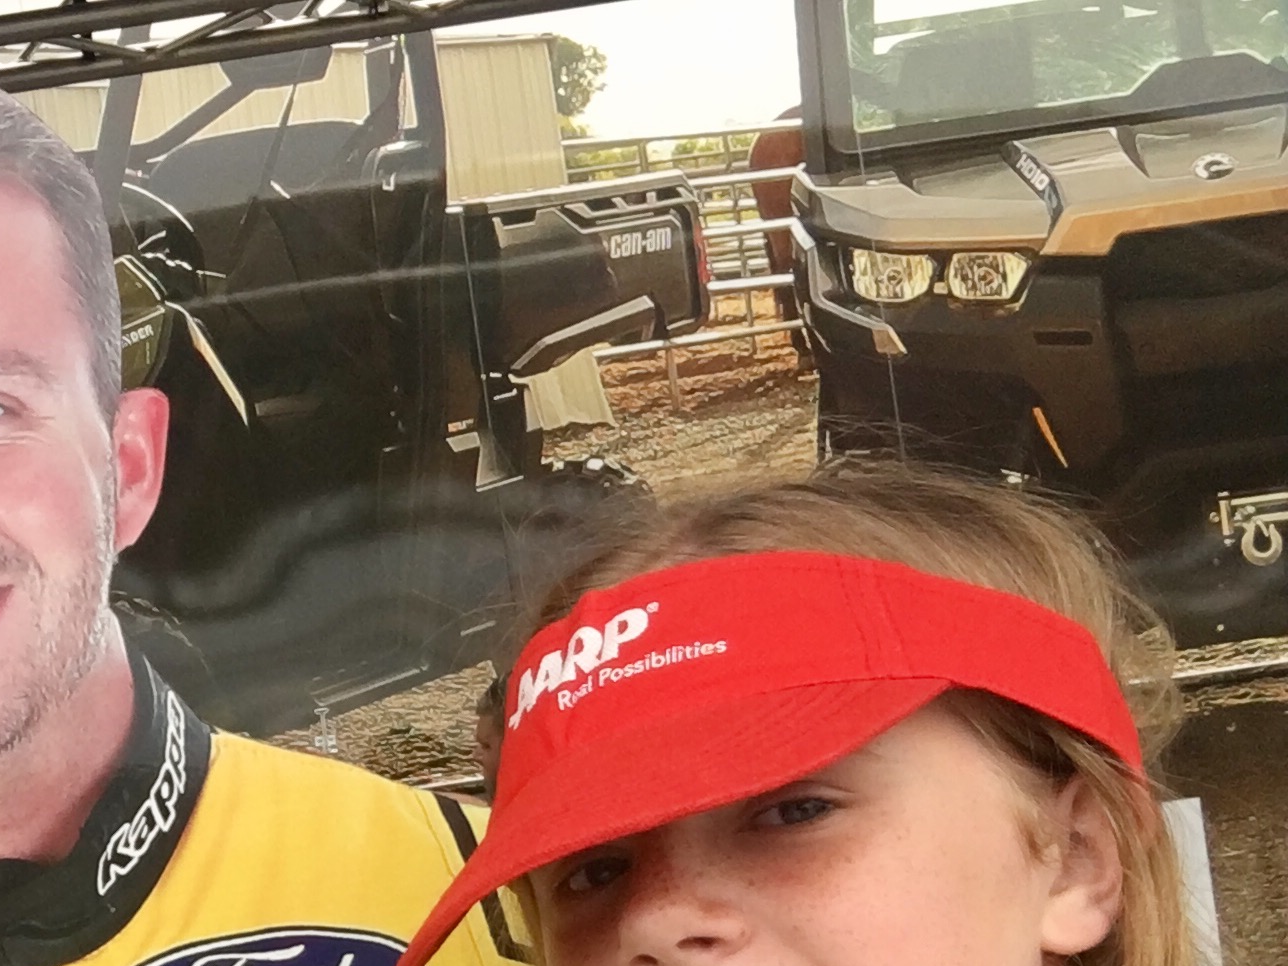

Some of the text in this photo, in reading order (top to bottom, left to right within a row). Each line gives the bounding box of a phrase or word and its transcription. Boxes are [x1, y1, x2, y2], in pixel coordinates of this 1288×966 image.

[610, 227, 672, 259] can-am
[508, 608, 649, 730] AARP
[557, 640, 727, 711] Real Possibilities
